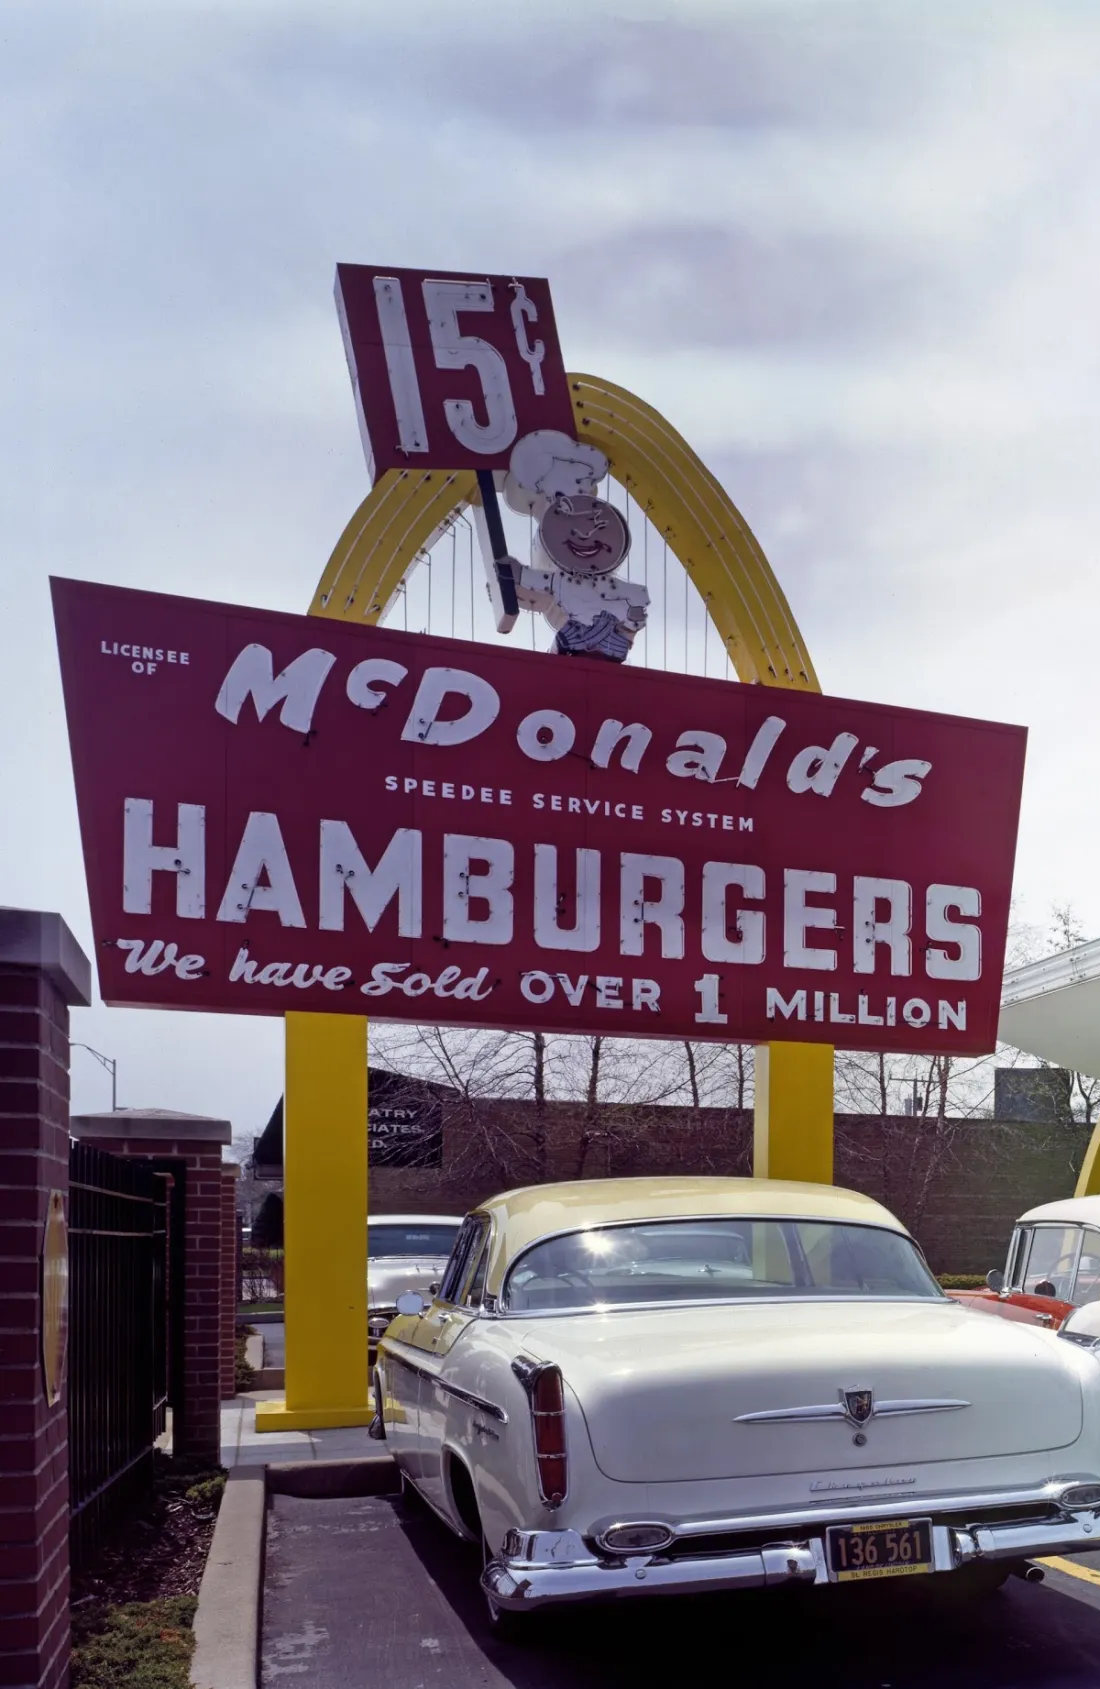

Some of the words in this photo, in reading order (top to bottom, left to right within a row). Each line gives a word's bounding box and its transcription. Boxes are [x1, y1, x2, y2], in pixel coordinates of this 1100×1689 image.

[372, 276, 546, 455] 15¢
[100, 640, 190, 665] LICENSEE
[131, 660, 158, 676] OF
[214, 643, 933, 807] McDonald's
[385, 775, 513, 805] SPEEDEE
[532, 792, 645, 820] SERVICE
[661, 808, 754, 833] SYSTEM
[122, 796, 983, 982] HAMBURGERS
[116, 938, 207, 981] We
[228, 946, 353, 991] have
[360, 962, 495, 1001] Sold
[519, 969, 662, 1012] OVER
[694, 973, 729, 1025] 1
[765, 986, 967, 1032] MILLION
[838, 1535, 878, 1567] 136
[885, 1531, 922, 1562] 561
[863, 1569, 884, 1577] REGIS
